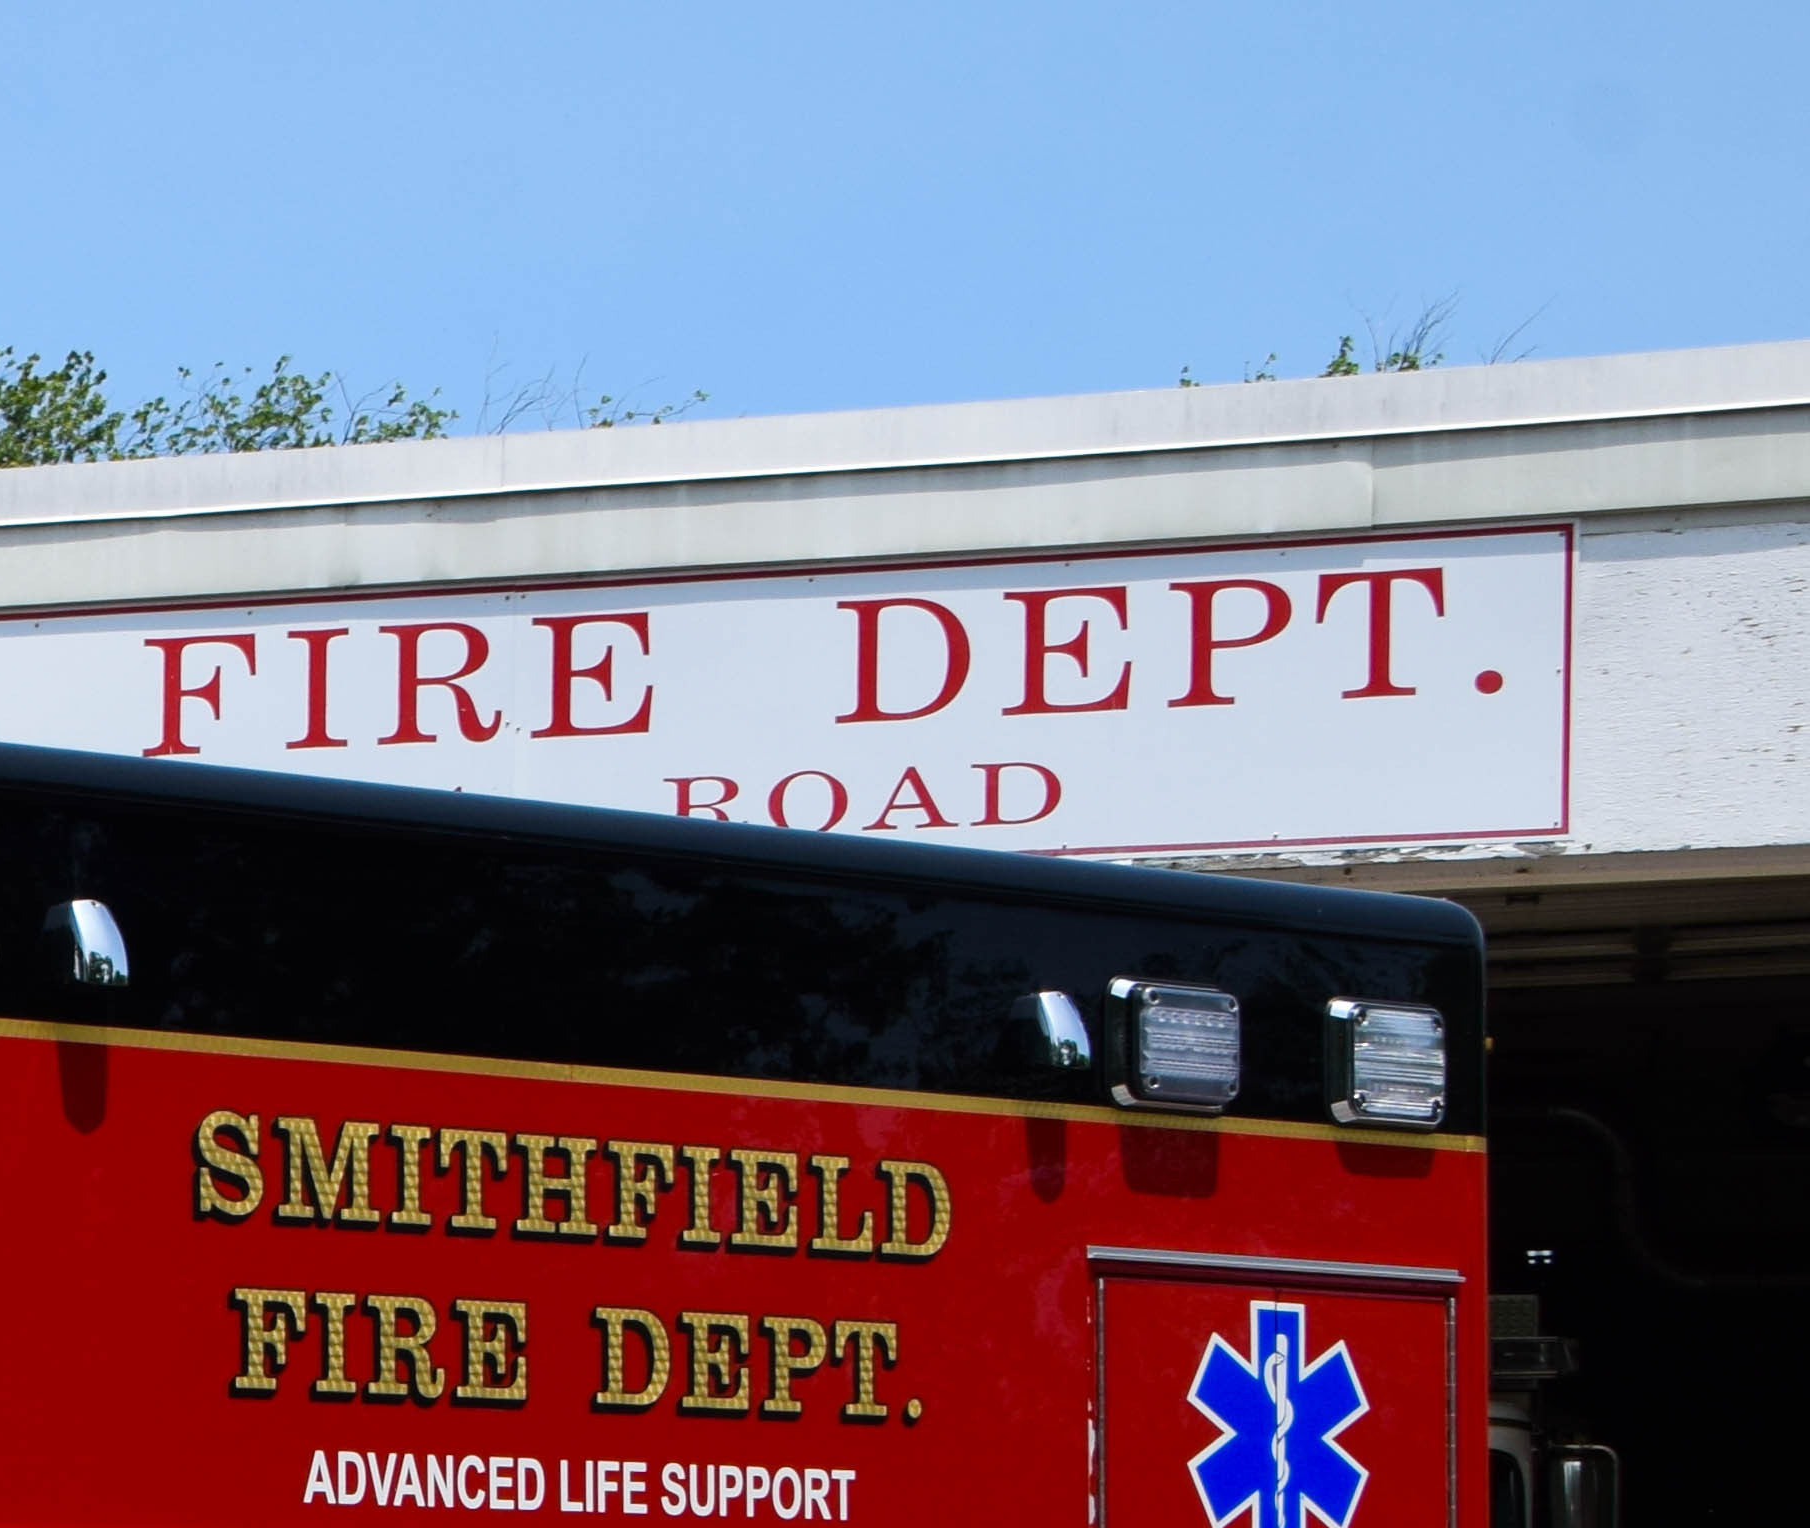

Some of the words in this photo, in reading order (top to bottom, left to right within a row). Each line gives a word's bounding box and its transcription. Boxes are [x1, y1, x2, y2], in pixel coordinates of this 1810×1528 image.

[142, 612, 653, 757] FIRE
[836, 567, 1505, 725] DEPT.
[664, 762, 1062, 832] ROAD
[194, 1108, 951, 1258] SMITHFIELD
[231, 1287, 528, 1401] FIRE
[591, 1306, 922, 1421] DEPT.
[303, 1449, 545, 1513] ADVANCED
[560, 1459, 649, 1515] LIFE
[660, 1462, 857, 1521] SUPPORT
